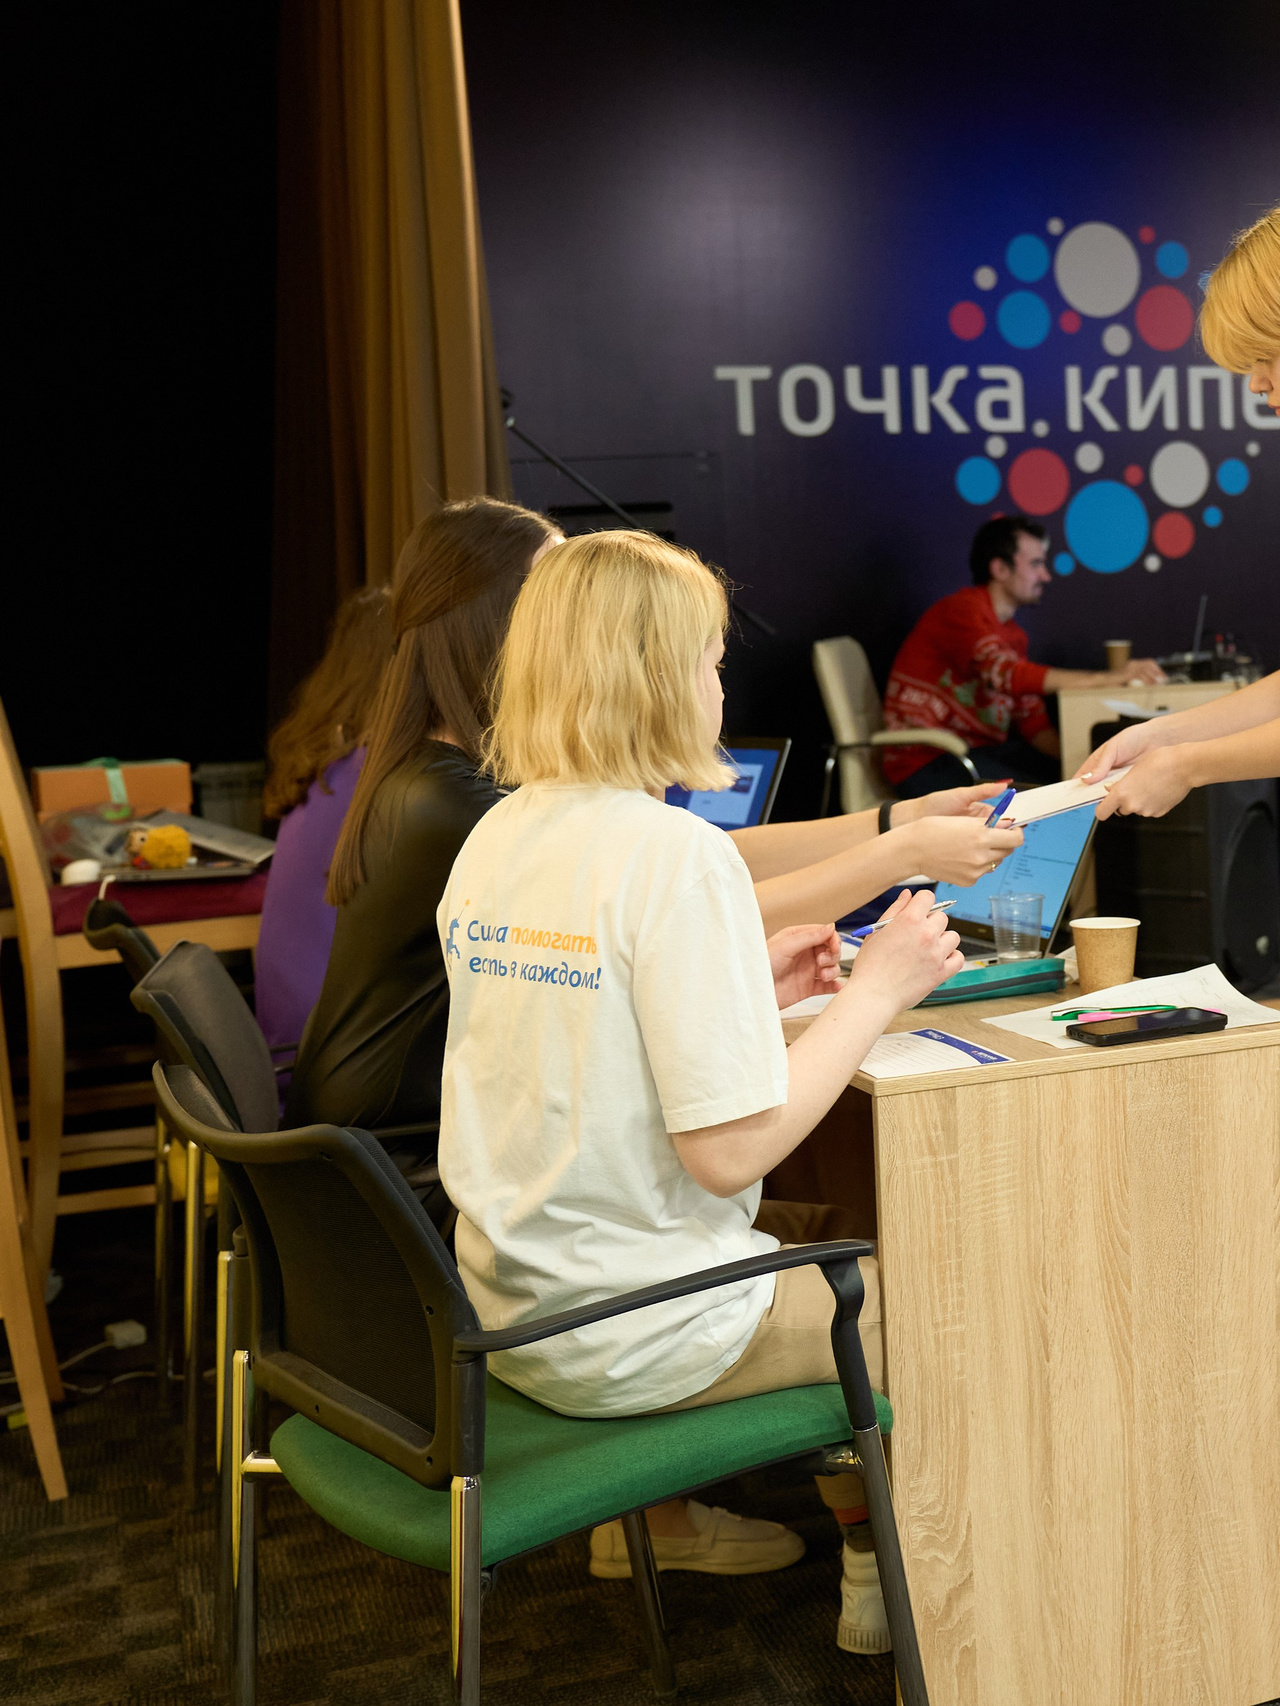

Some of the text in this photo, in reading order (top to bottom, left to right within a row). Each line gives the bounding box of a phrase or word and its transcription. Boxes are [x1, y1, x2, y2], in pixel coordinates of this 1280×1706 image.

[511, 926, 597, 955] помогать
[511, 960, 517, 978] в
[520, 961, 602, 990] каждом!
